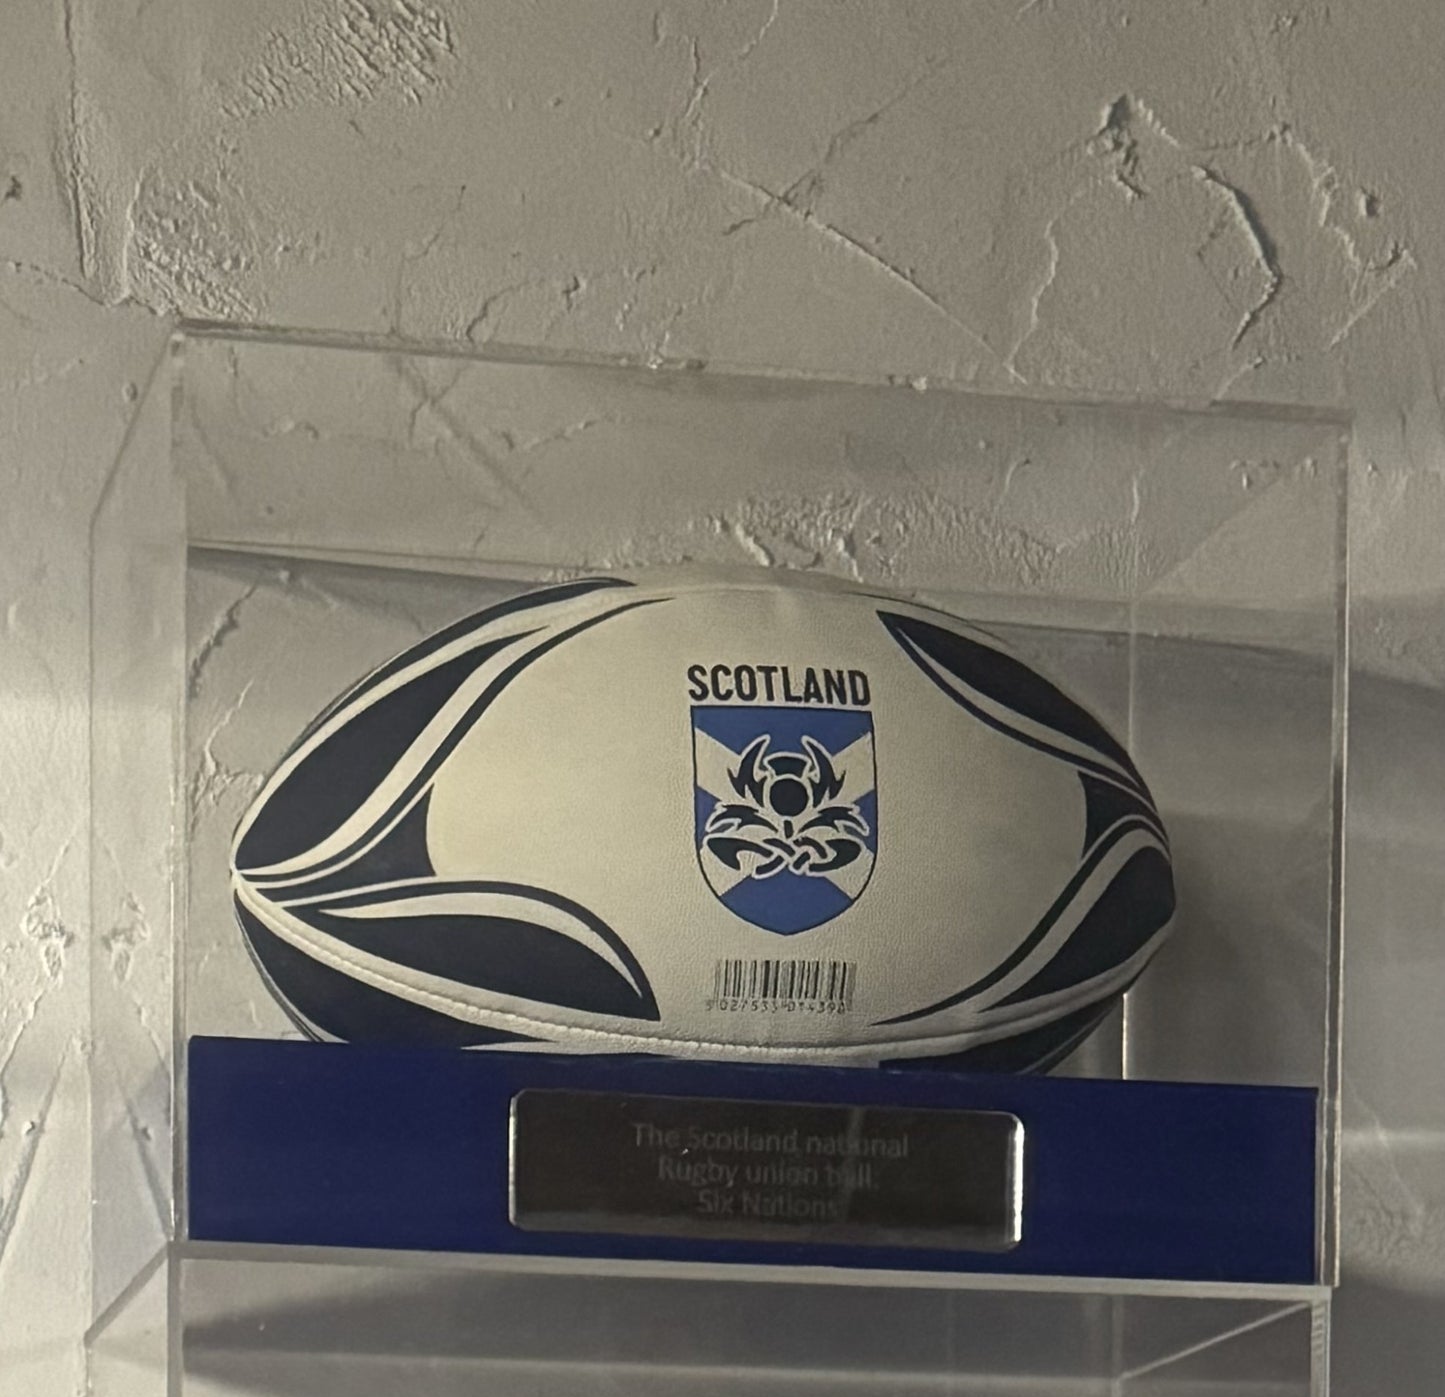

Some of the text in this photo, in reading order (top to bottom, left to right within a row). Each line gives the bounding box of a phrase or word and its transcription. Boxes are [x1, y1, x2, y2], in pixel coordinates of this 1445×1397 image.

[687, 664, 871, 706] SCOTLAND
[632, 1122, 679, 1149] The
[685, 1125, 799, 1154] Scotland
[658, 1154, 739, 1188] Rugby
[746, 1159, 819, 1186] union
[697, 1189, 733, 1215] Six
